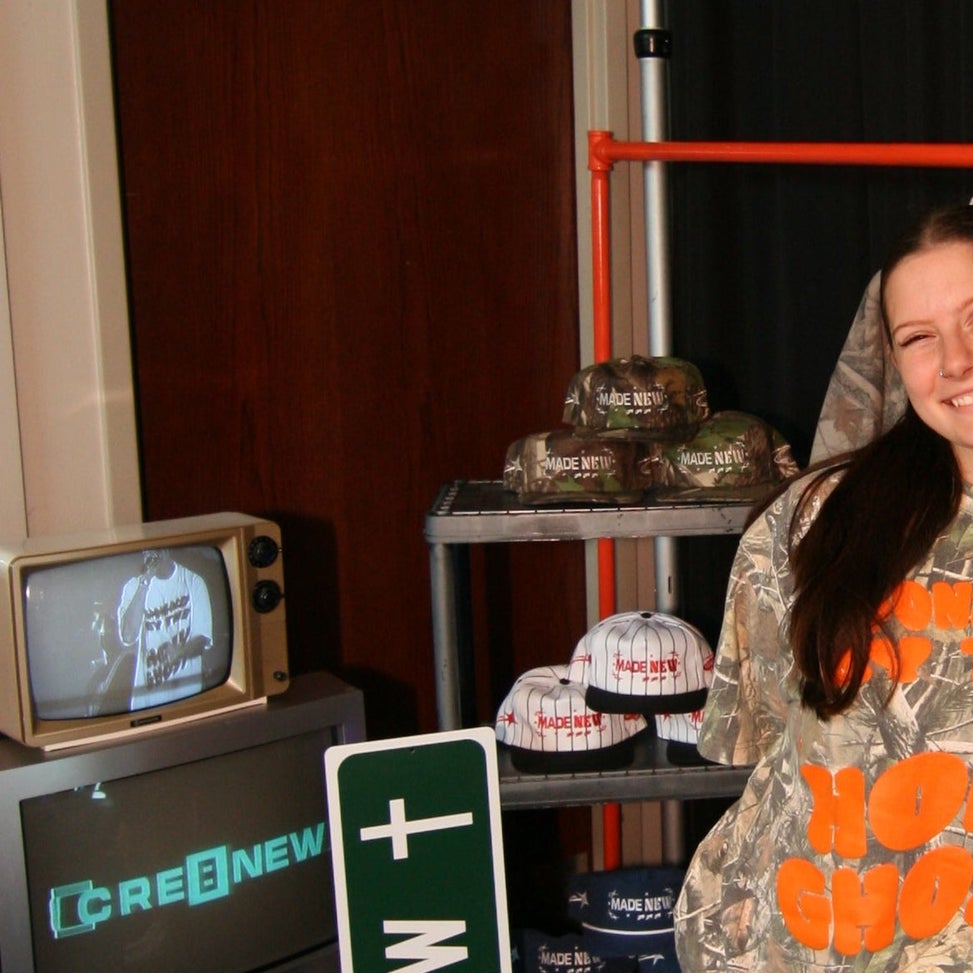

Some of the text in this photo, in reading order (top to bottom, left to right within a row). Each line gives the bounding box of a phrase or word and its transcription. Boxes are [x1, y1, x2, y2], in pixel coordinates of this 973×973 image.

[599, 391, 664, 406] MADE NEW
[545, 455, 612, 471] MADE NEW
[681, 449, 746, 466] MADE NEW
[615, 658, 678, 674] MADE NEW
[538, 713, 602, 730] MADE NEW
[611, 896, 671, 911] MADE NEW
[541, 952, 572, 966] MADE
